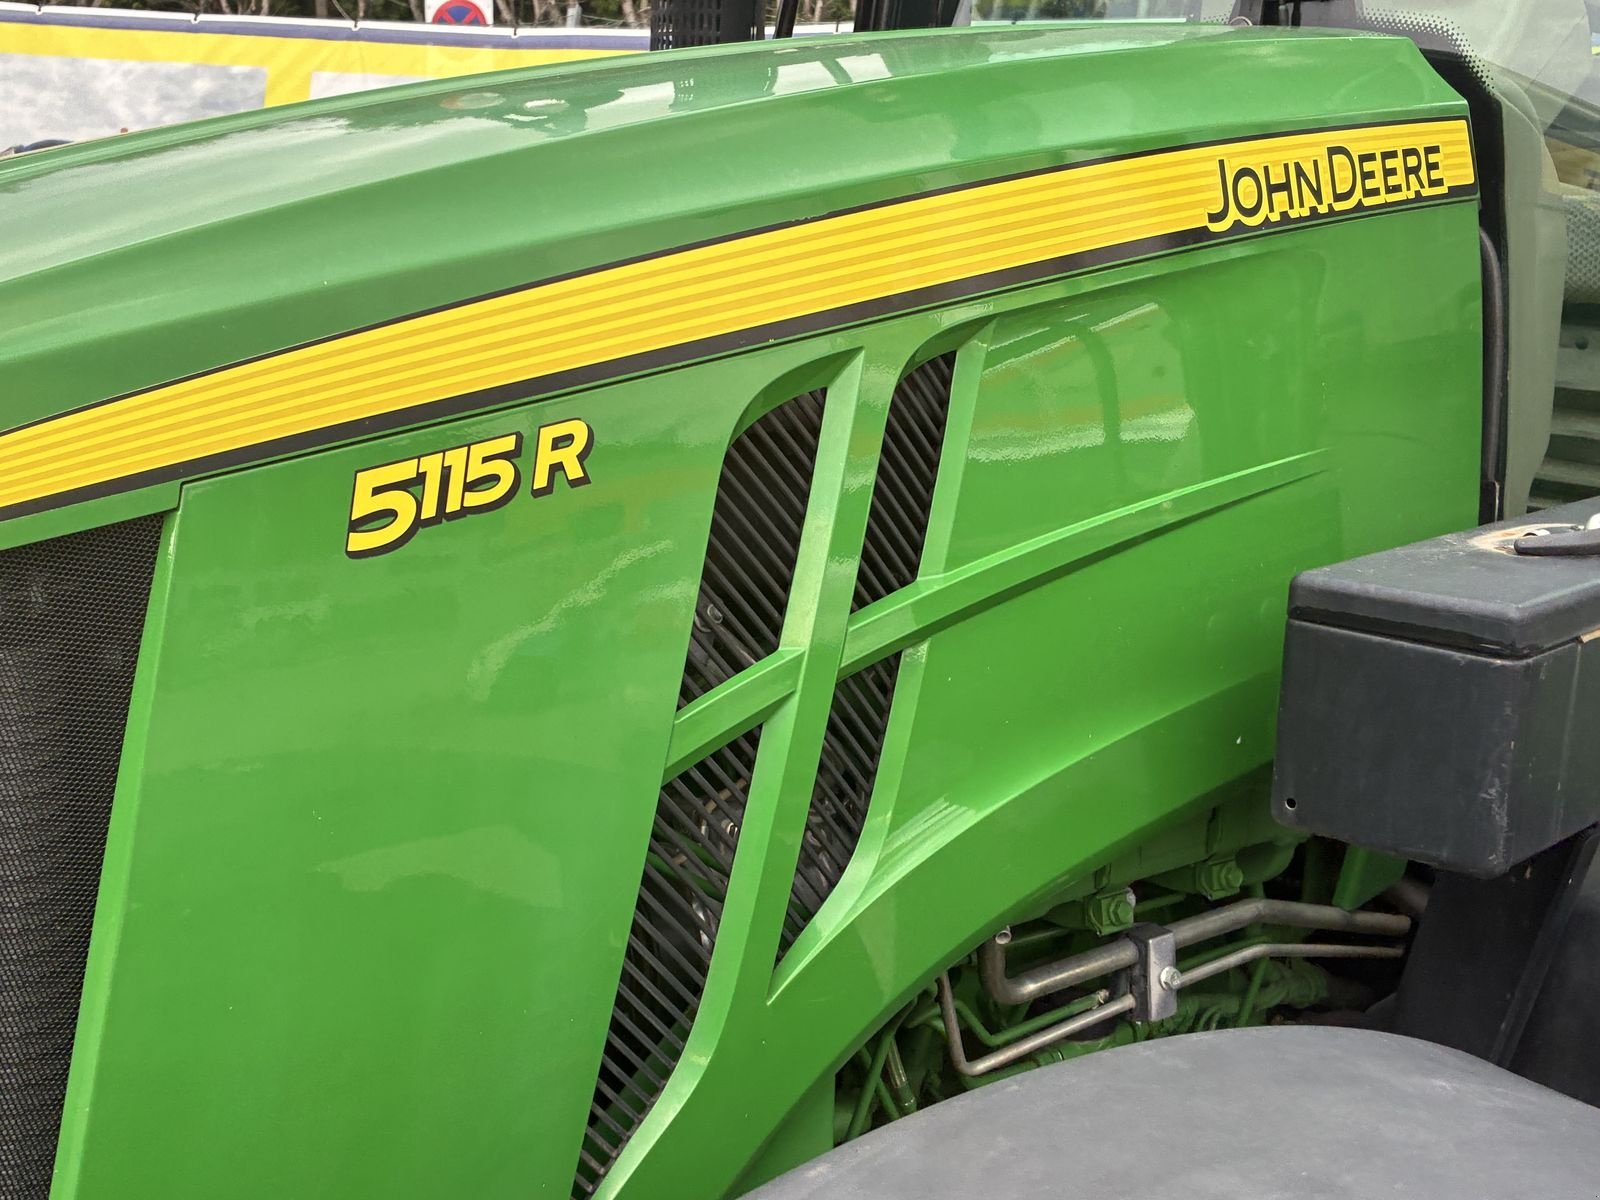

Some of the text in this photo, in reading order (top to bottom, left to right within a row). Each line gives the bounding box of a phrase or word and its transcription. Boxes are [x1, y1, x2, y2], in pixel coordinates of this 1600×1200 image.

[1206, 144, 1446, 228] JOHN DEERE
[346, 418, 594, 559] 5115 R
